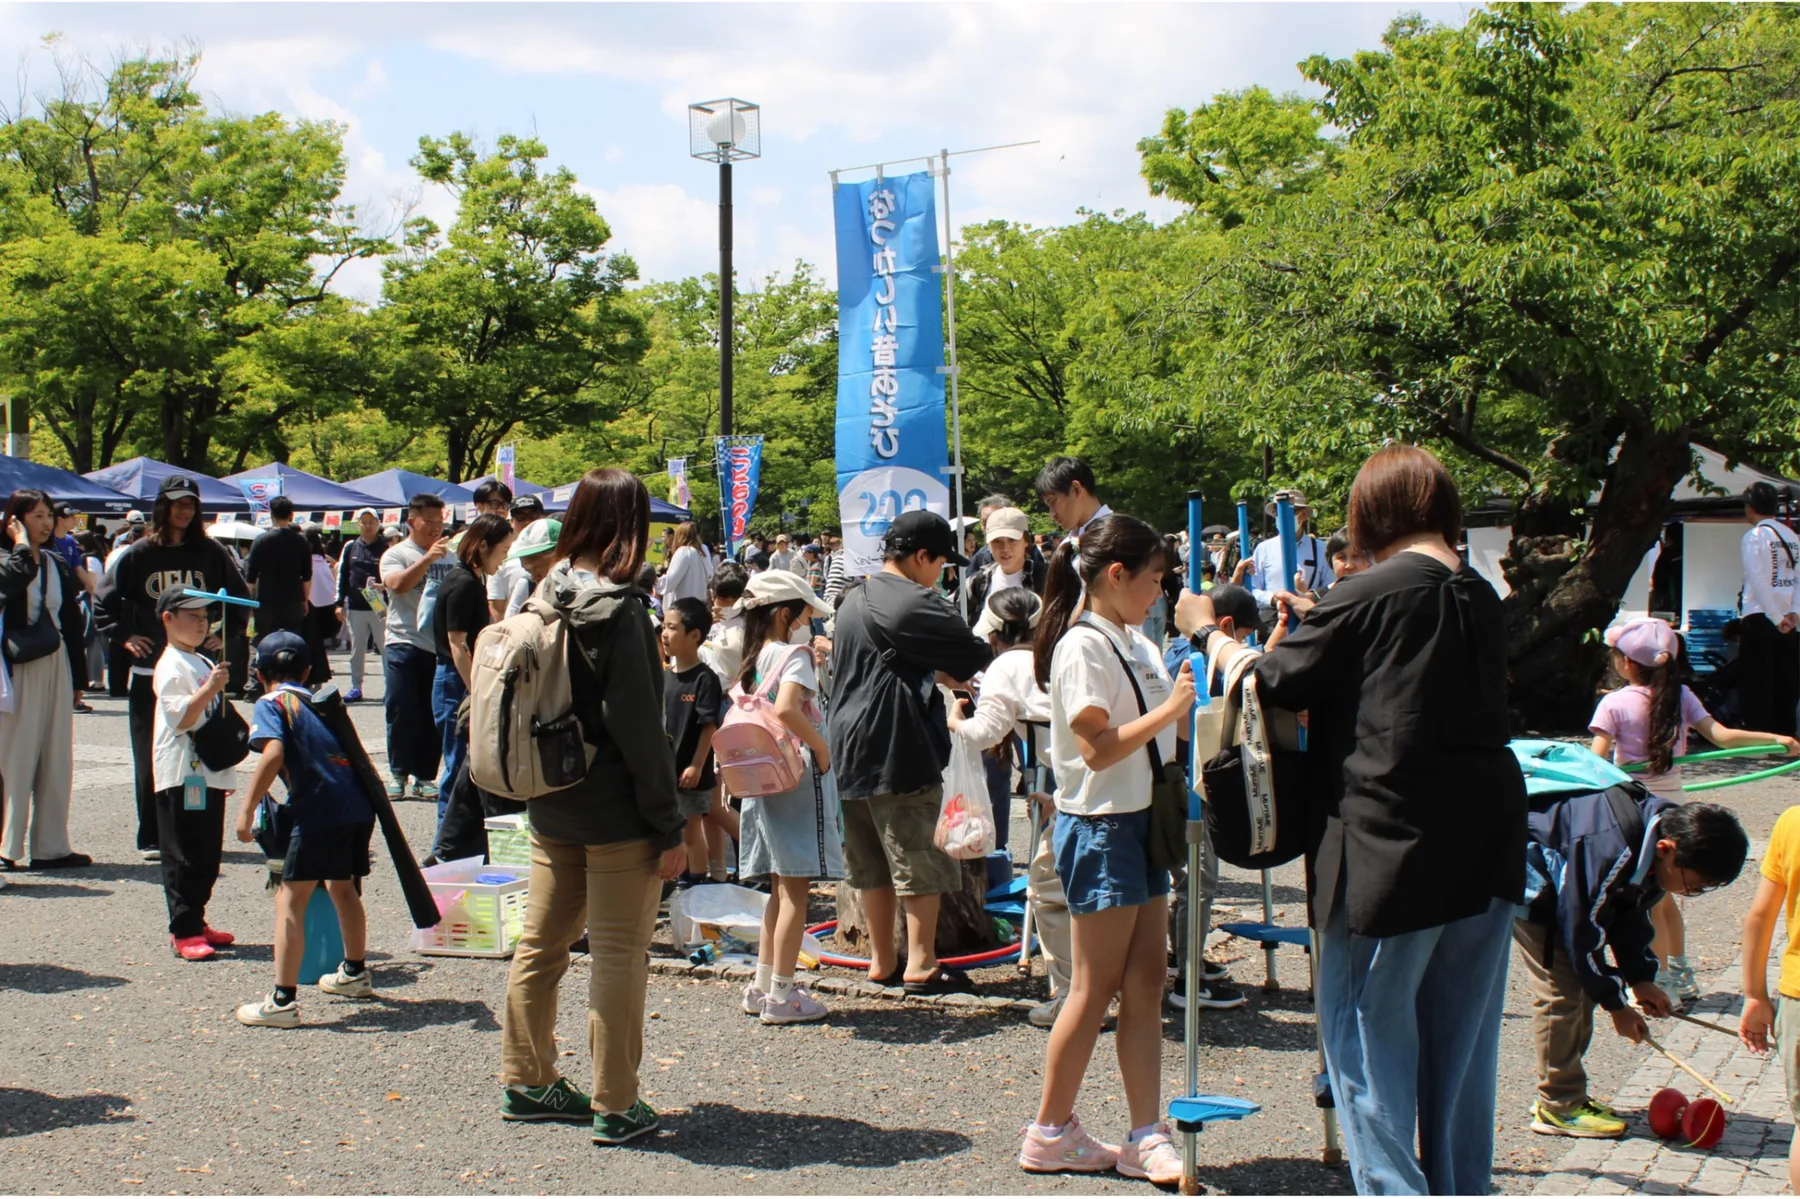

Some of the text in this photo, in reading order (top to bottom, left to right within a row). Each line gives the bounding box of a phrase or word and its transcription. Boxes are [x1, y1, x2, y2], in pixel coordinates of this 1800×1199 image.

[1249, 764, 1259, 797] MumME
[1261, 794, 1271, 827] MumME
[1256, 817, 1264, 850] MumME
[544, 1088, 570, 1110] N
